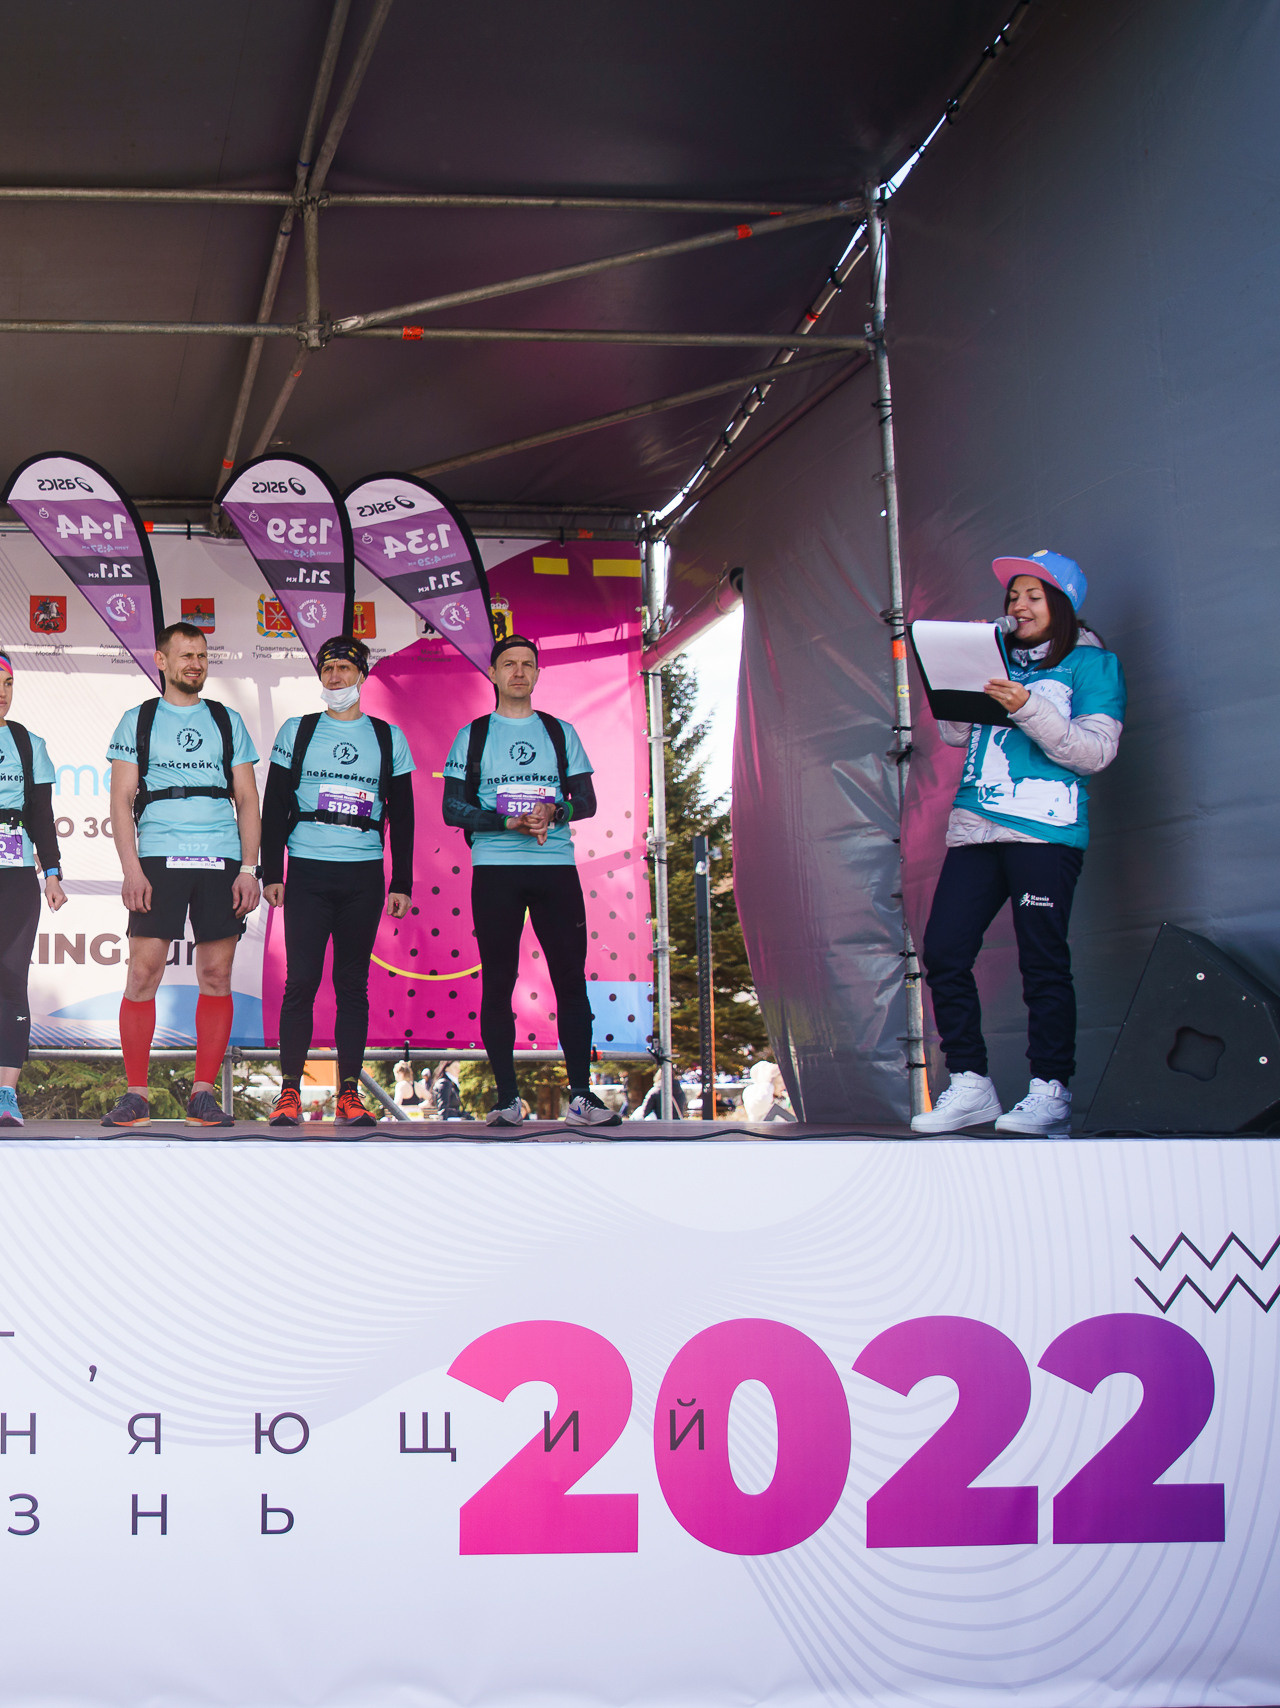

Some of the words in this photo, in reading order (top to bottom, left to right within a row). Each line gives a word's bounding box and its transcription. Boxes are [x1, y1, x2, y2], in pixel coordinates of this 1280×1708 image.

[306, 769, 378, 785] пейсмейкер
[487, 773, 559, 785] пейсмейкер
[328, 801, 359, 815] 5128
[446, 1312, 1226, 1556] 2022
